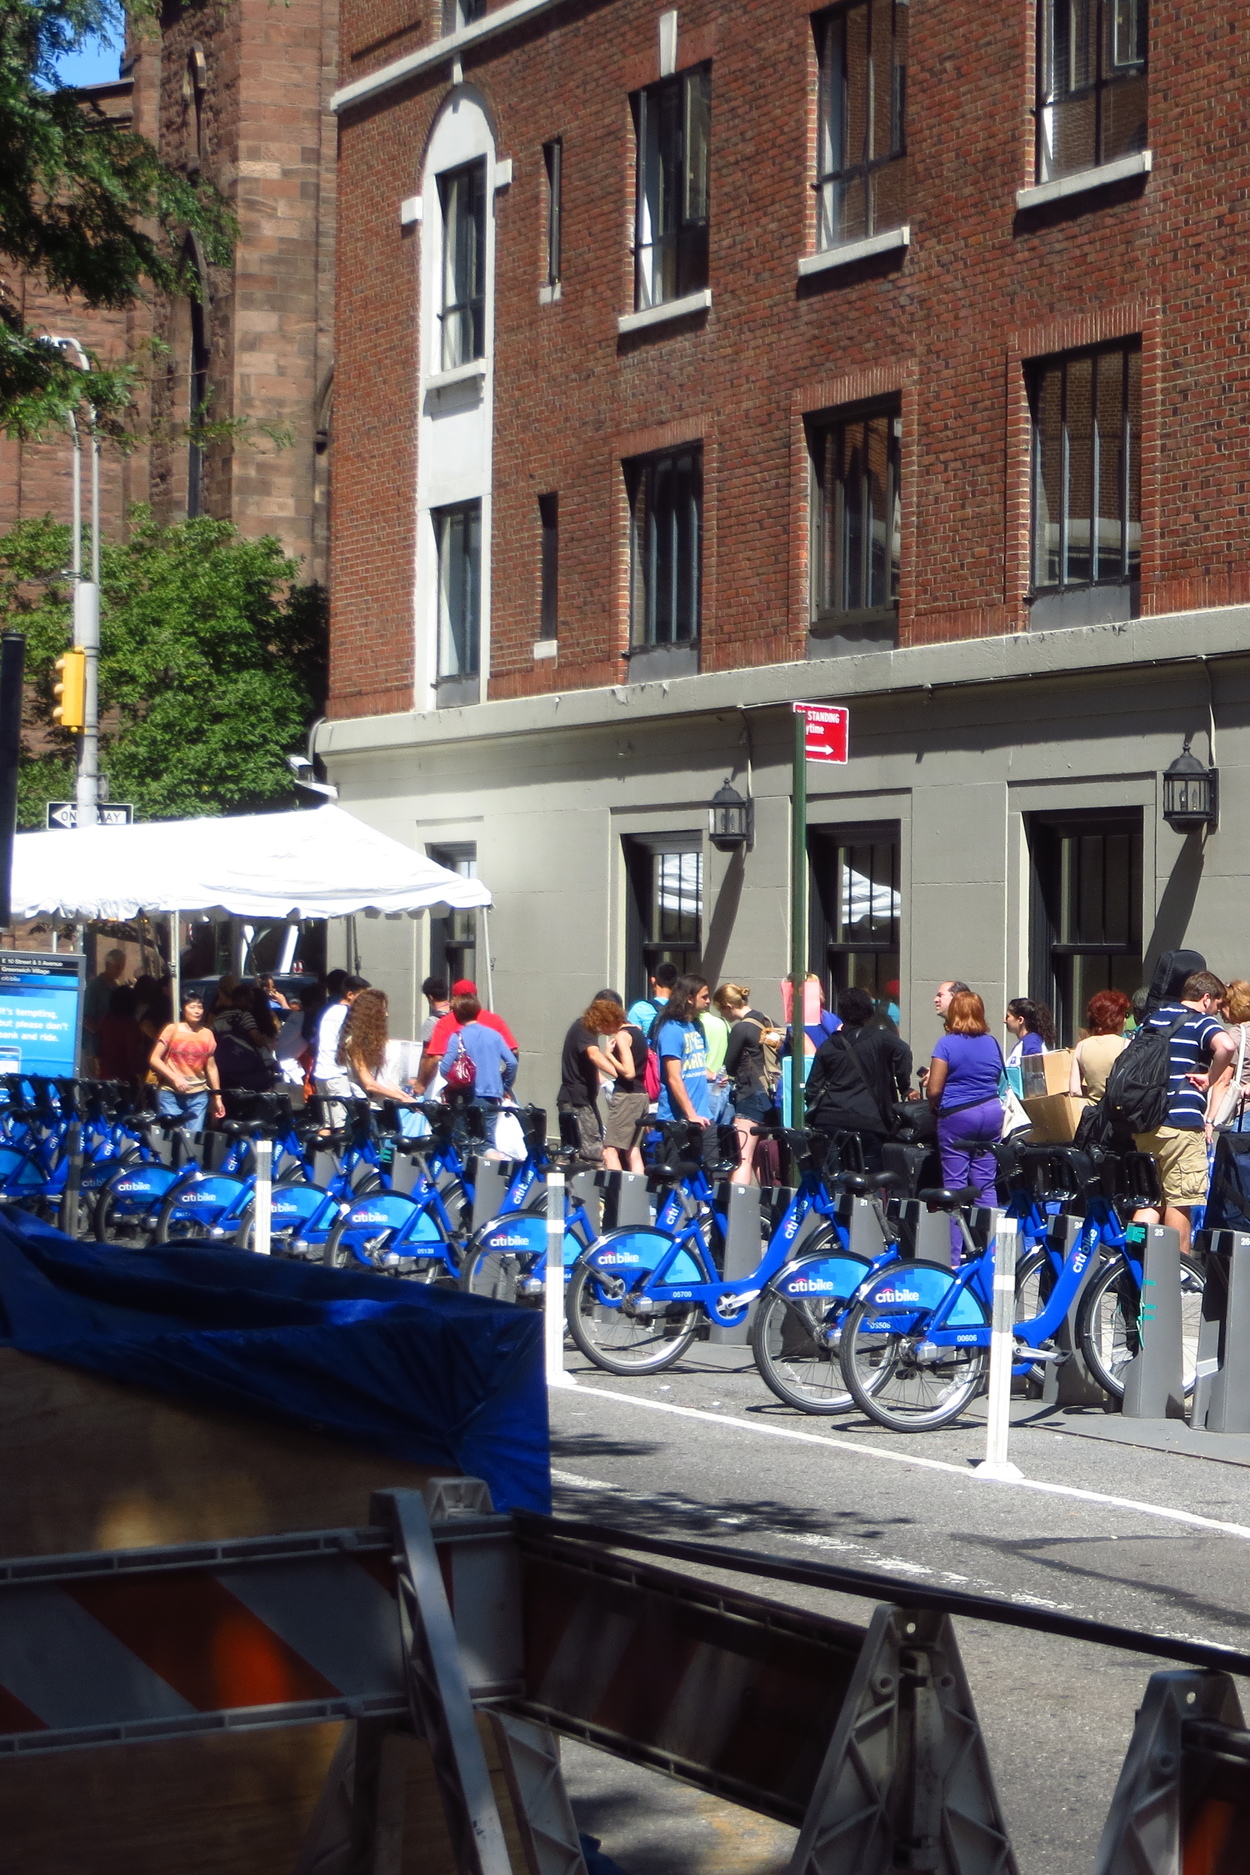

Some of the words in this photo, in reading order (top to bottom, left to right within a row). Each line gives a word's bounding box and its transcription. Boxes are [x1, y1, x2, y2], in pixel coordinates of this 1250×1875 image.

[807, 711, 841, 724] STANDING
[805, 724, 825, 735] ytime
[60, 811, 77, 821] ON
[15, 1008, 58, 1020] tempting,
[16, 1020, 44, 1029] please
[45, 1022, 69, 1031] don't
[21, 1033, 38, 1041] and
[40, 1033, 60, 1042] ride.
[118, 1180, 132, 1191] citi
[132, 1181, 151, 1191] bike
[181, 1192, 197, 1202] citi
[197, 1192, 217, 1202] bike
[277, 1202, 298, 1212] bike
[860, 1199, 868, 1207] 21
[351, 1211, 368, 1222] citi
[368, 1212, 389, 1222] bike
[785, 1220, 800, 1240] citi
[1154, 1228, 1165, 1238] 25
[490, 1235, 507, 1247] citi
[507, 1235, 530, 1246] bike
[1240, 1237, 1250, 1247] 26
[1072, 1251, 1088, 1274] citi
[1081, 1228, 1099, 1256] bike
[597, 1251, 616, 1265] citi
[616, 1251, 640, 1263] bike
[788, 1278, 808, 1293] citi
[808, 1278, 834, 1291] bike
[875, 1288, 895, 1303] citi
[894, 1289, 920, 1302] bike
